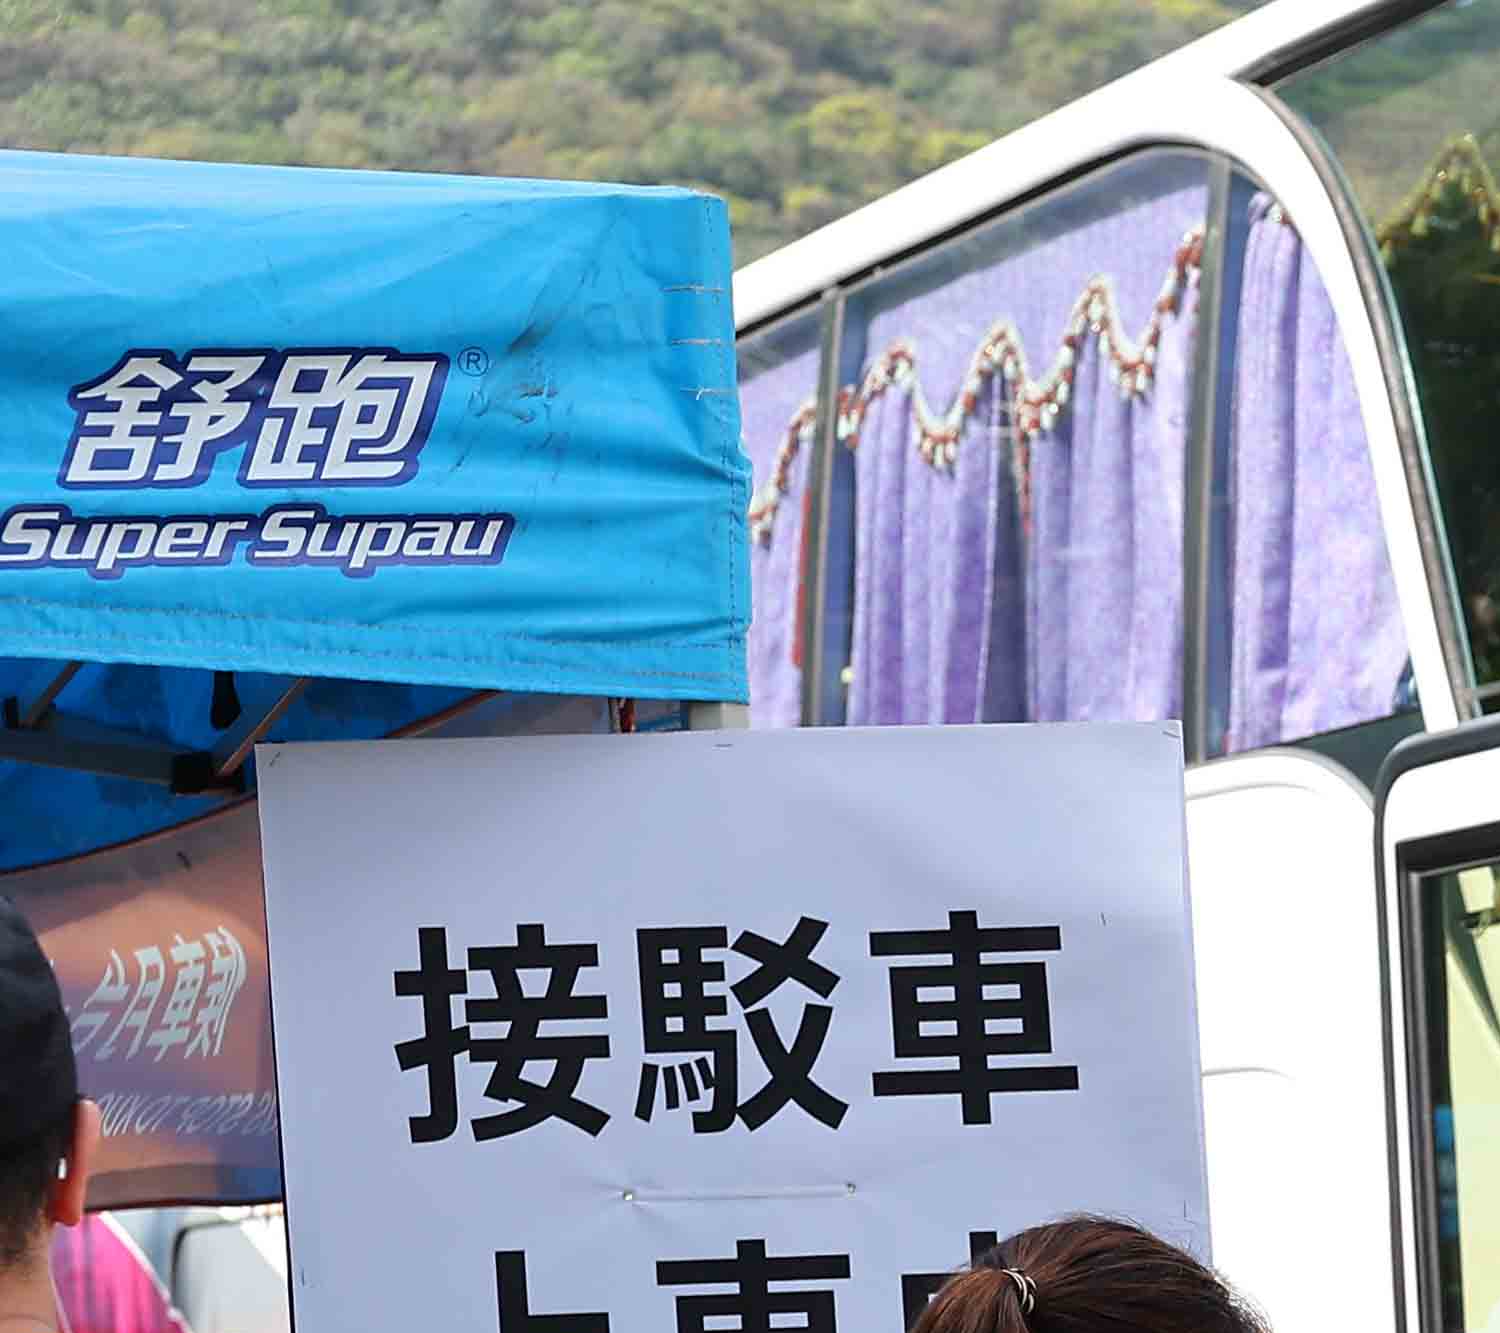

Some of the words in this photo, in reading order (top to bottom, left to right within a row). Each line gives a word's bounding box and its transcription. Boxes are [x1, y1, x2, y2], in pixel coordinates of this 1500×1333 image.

[62, 352, 443, 484] 舒跑
[0, 510, 250, 570] Super
[253, 510, 505, 570] Supau
[394, 910, 1080, 1145] 接駁車
